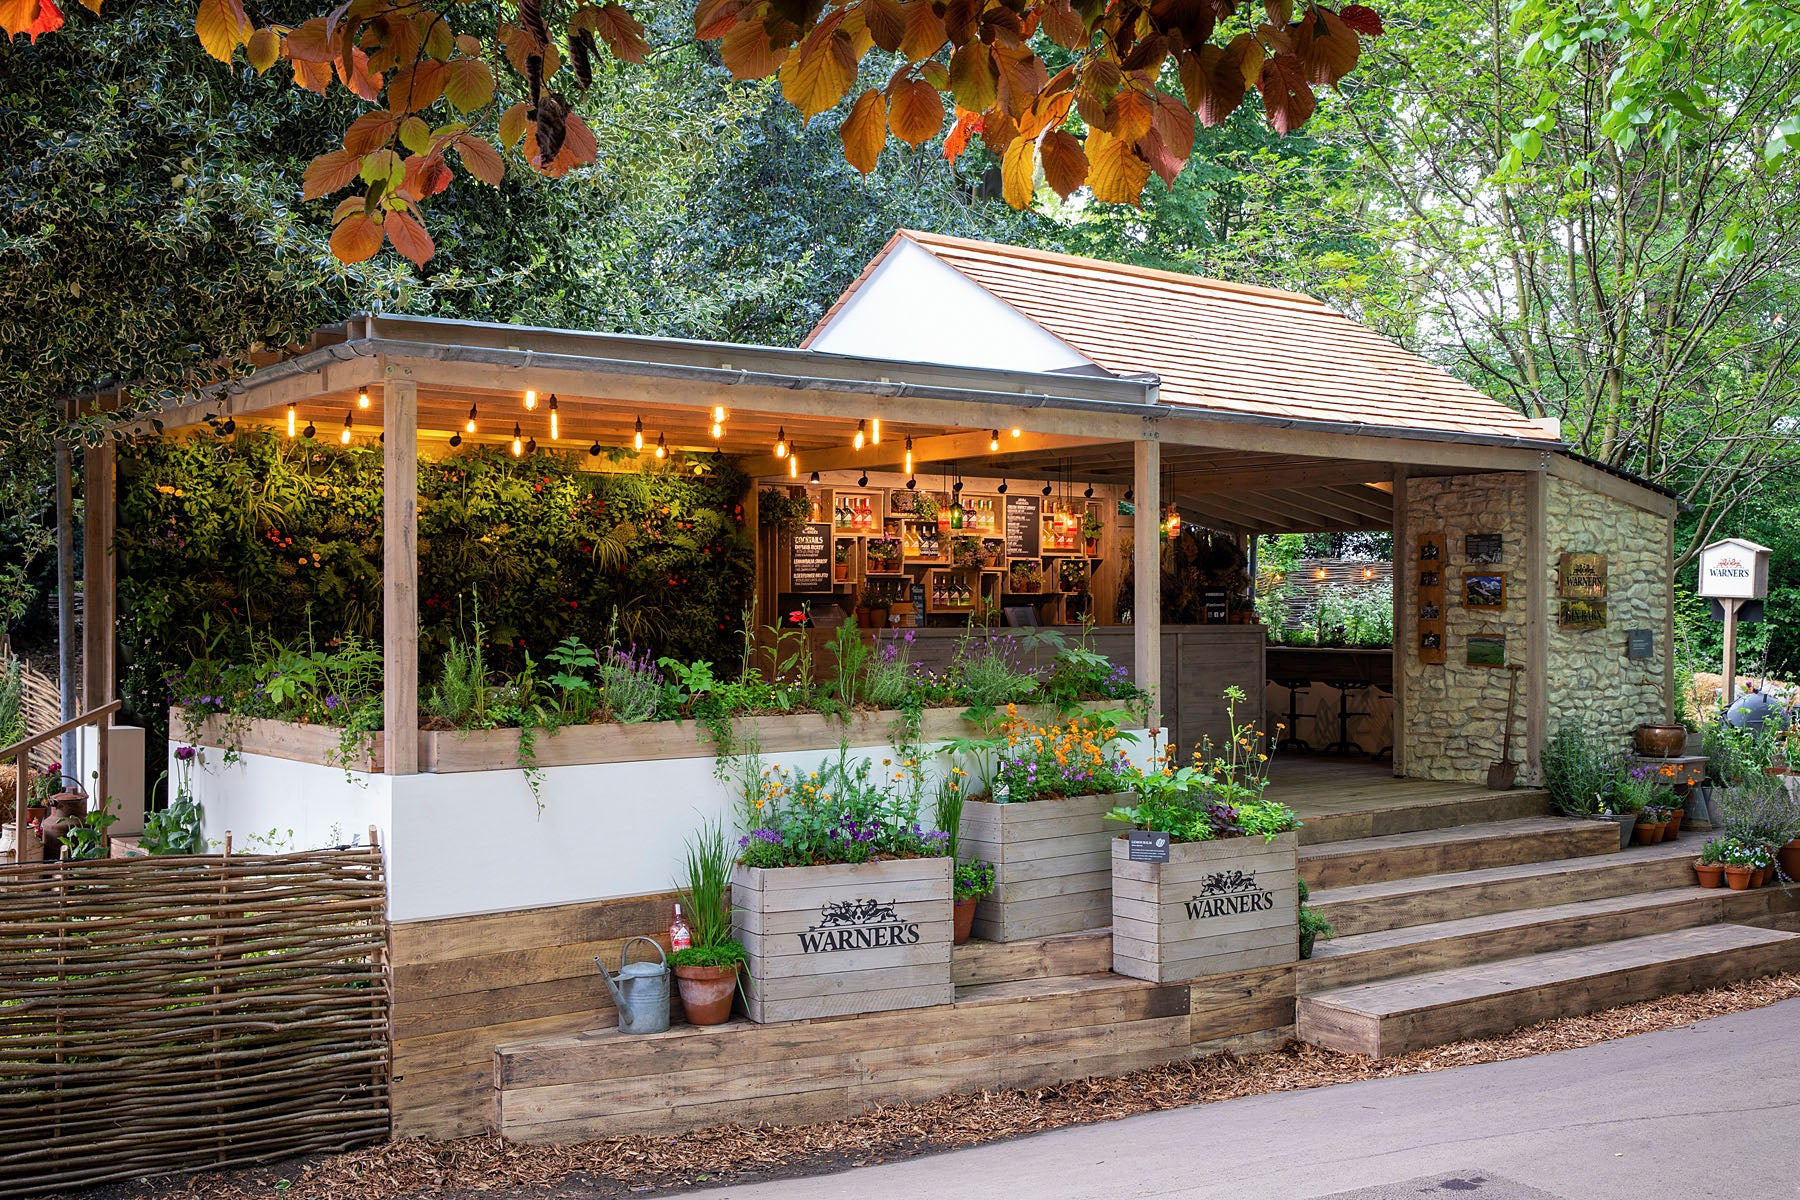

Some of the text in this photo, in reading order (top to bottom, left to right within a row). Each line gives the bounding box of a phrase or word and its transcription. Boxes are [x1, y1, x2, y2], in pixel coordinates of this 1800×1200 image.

[794, 536, 824, 544] COCKTAILS
[1709, 568, 1750, 578] WARNER'S
[1565, 609, 1602, 621] GIN BARN
[1183, 891, 1274, 920] WARNER'S
[797, 923, 920, 953] WARNER'S
